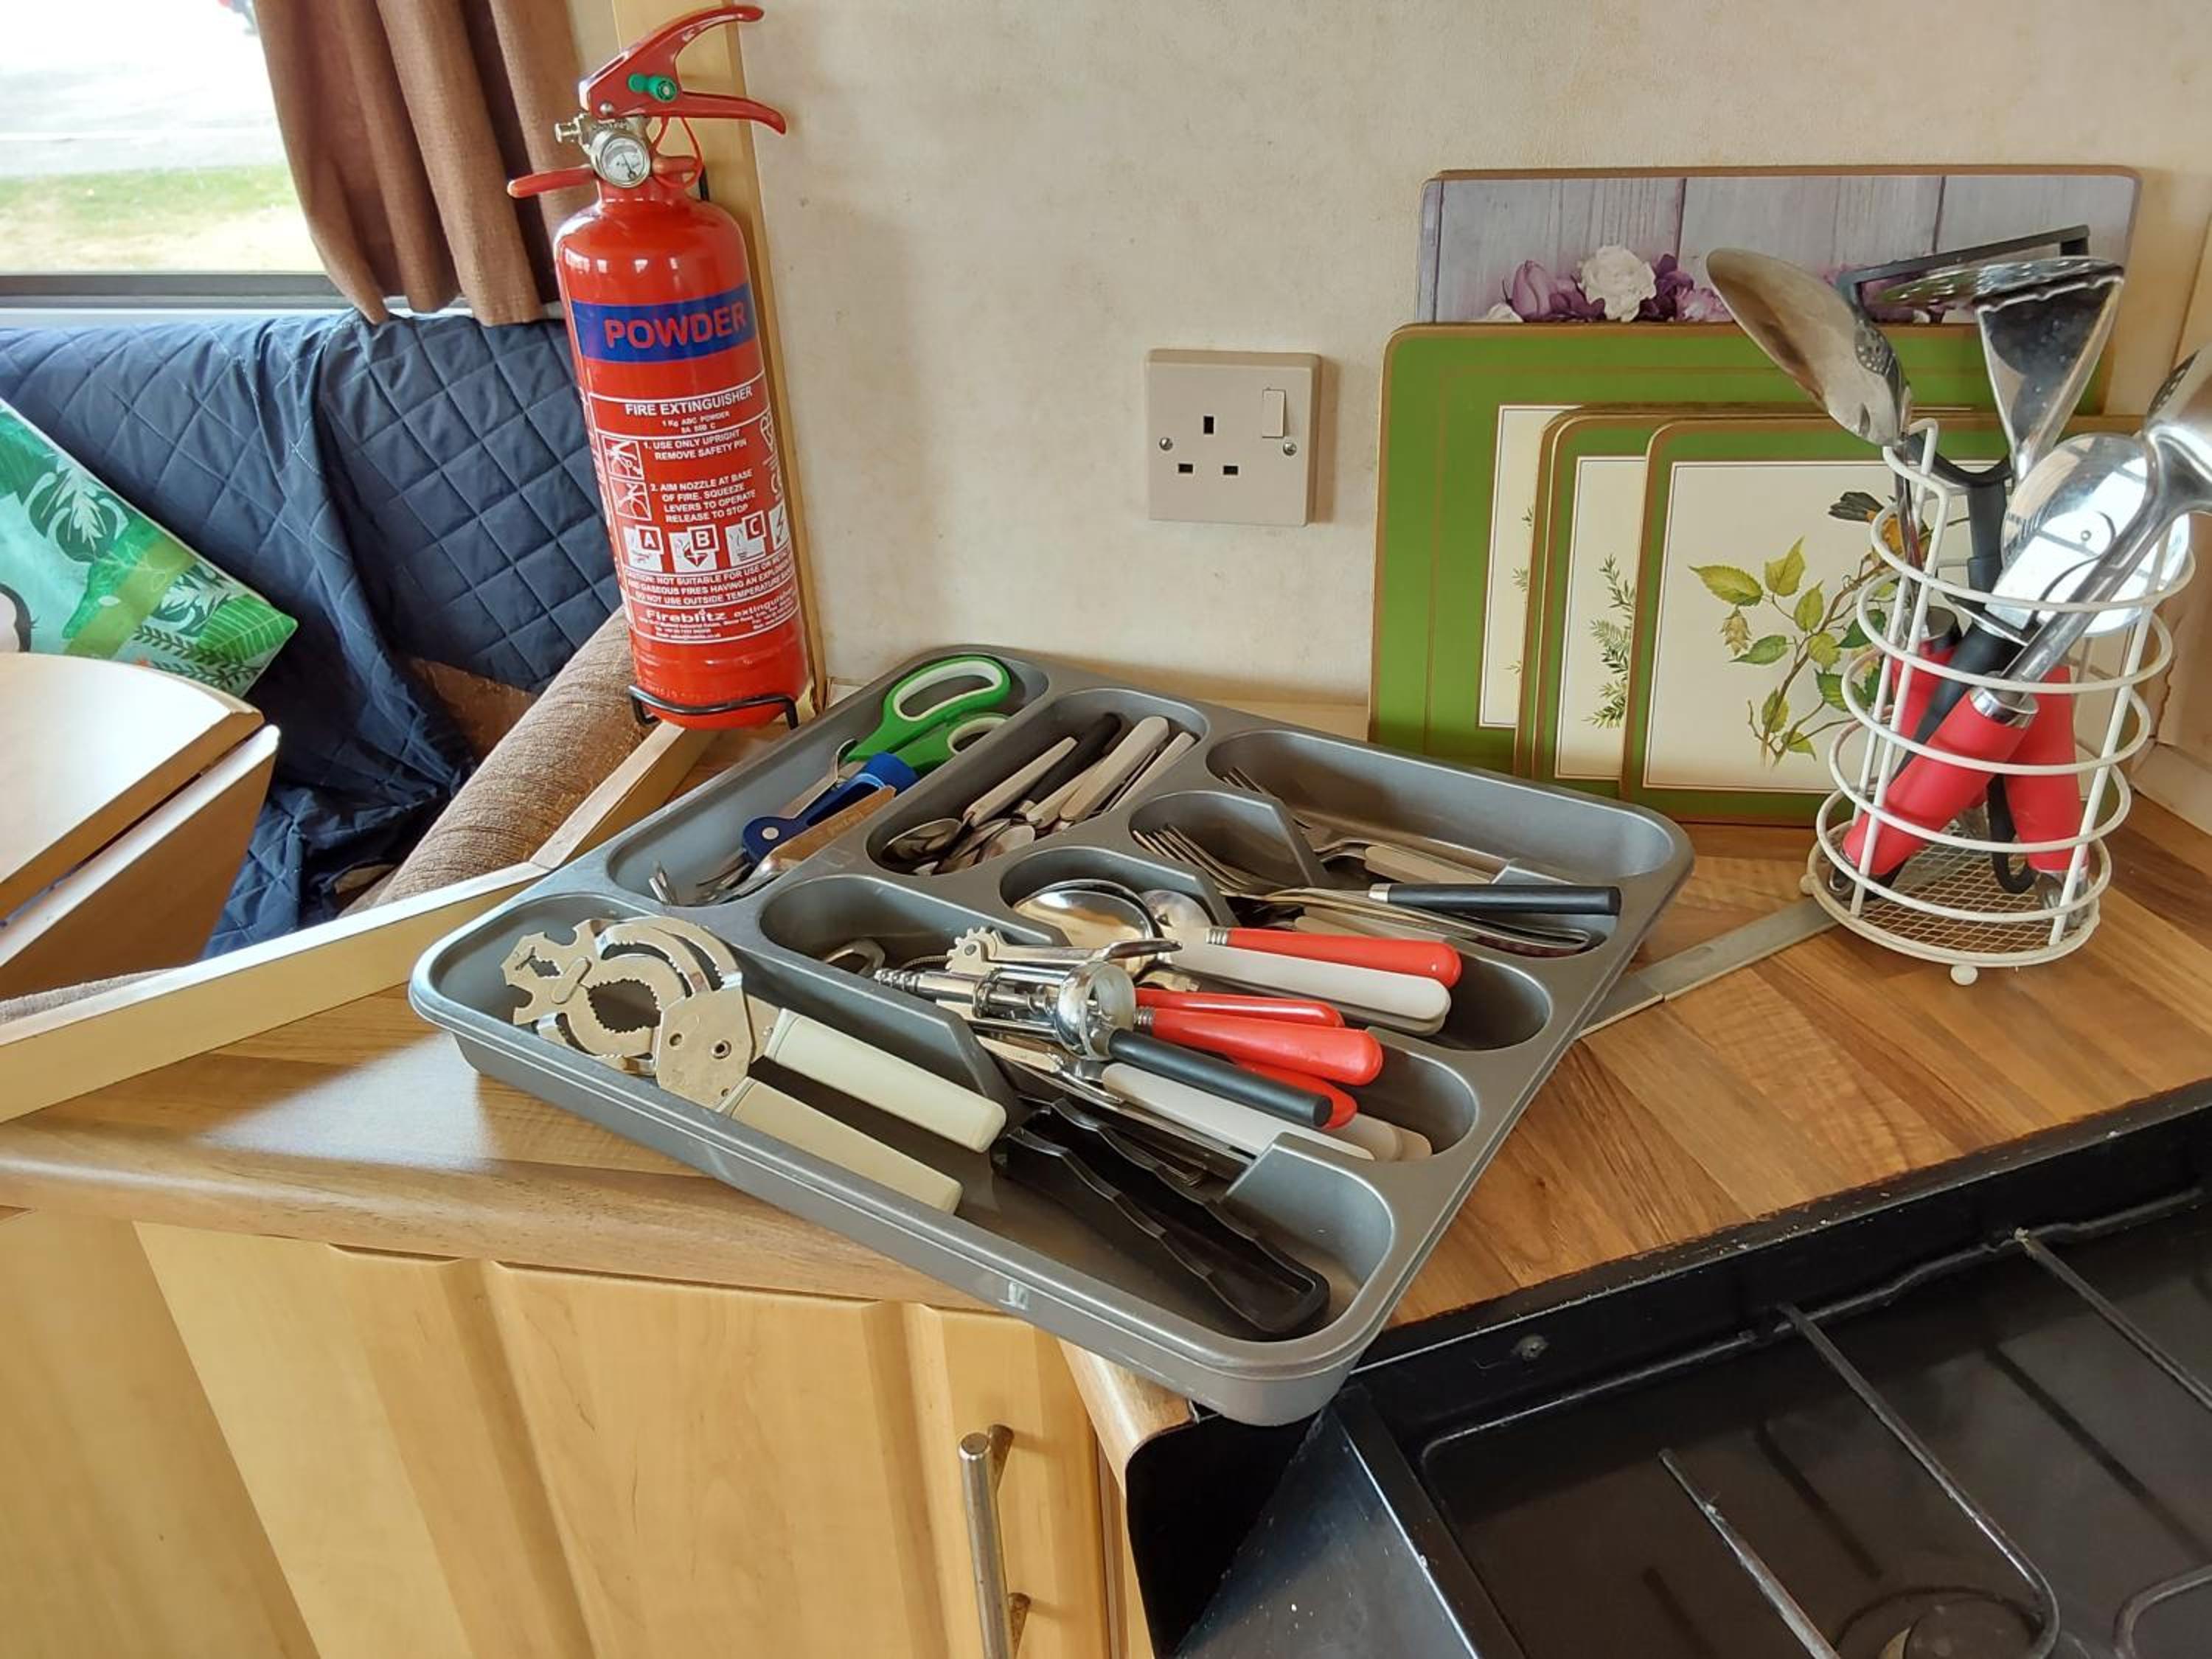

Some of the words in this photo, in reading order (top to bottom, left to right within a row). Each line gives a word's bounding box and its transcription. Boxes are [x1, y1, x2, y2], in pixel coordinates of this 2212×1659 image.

[603, 301, 747, 349] POWDER
[625, 403, 657, 416] FIRE
[660, 386, 753, 416] EXTINGUISHER
[700, 411, 730, 422] POWDER
[653, 441, 673, 451] USE
[675, 438, 700, 449] ONLY
[702, 429, 740, 446] UPRIGHT
[655, 449, 696, 461] REMOVE
[698, 443, 732, 458] SAFETY
[733, 439, 748, 450] PIN
[650, 484, 658, 492] 2.
[660, 483, 678, 492] AIM
[679, 479, 717, 491] NOZZLE
[718, 476, 730, 486] AT
[731, 468, 754, 483] BASE
[662, 494, 676, 502] OF
[678, 493, 703, 501] FIRE.
[703, 483, 745, 499] SQUEEZE
[664, 503, 701, 512] LEVERS
[703, 501, 717, 510] TO
[718, 489, 756, 507] OPERATE
[666, 512, 710, 523] RELEASE
[712, 509, 725, 519] TO
[726, 504, 748, 515] STOP
[750, 518, 760, 535] C
[644, 531, 656, 548] A
[695, 531, 710, 547] B
[676, 574, 722, 585] SUITABLE
[723, 570, 742, 580] FOR
[743, 564, 760, 575] USE
[641, 584, 680, 594] GASEOUS
[681, 585, 709, 595] FIRES
[710, 580, 744, 593] HAVING
[745, 576, 758, 585] AN
[646, 595, 661, 603] NOT
[664, 597, 682, 605] USE
[684, 594, 723, 605] OUTSIDE
[726, 575, 780, 600] TEMPERATURE
[646, 609, 726, 623] Fireblitz
